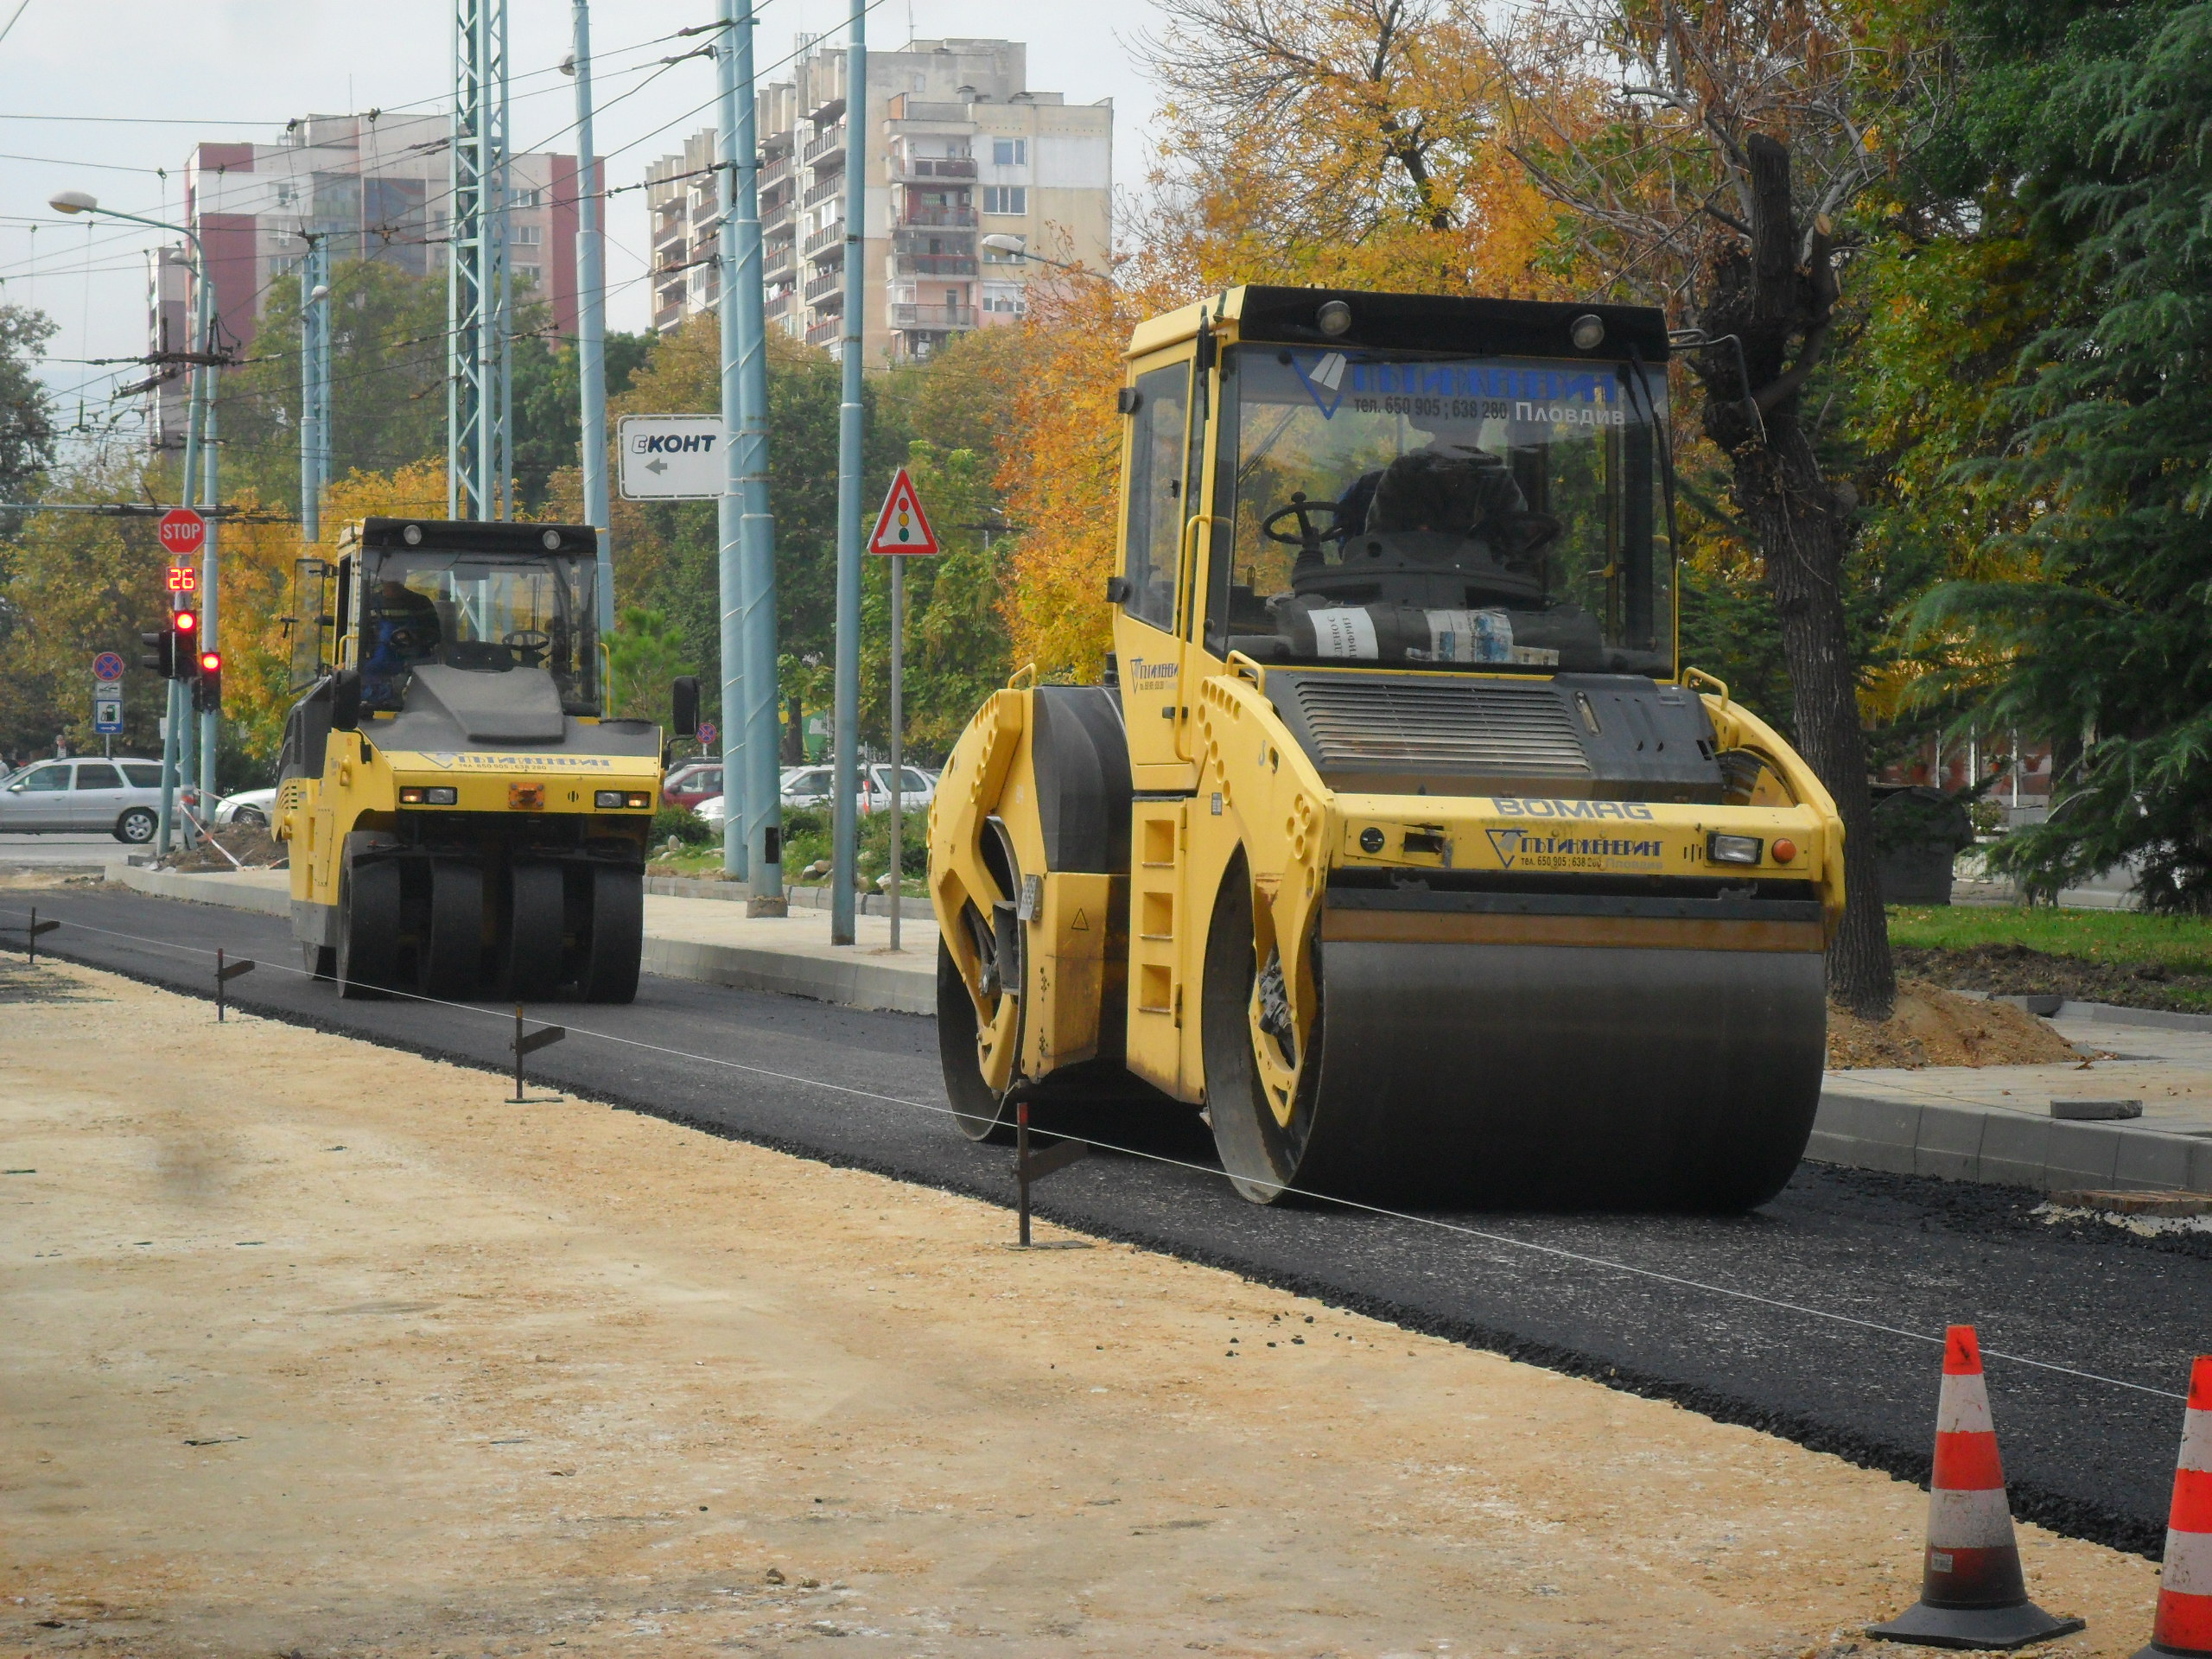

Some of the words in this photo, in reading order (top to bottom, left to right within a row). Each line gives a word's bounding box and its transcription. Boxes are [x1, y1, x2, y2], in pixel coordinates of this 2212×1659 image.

[1354, 398, 1380, 414] тел.
[1384, 397, 1410, 415] 650
[1414, 397, 1440, 416] 905
[1452, 400, 1478, 419] 638
[1481, 401, 1508, 420] 280
[162, 523, 200, 540] STOP
[168, 569, 195, 589] 26
[1491, 798, 1654, 820] BOMAG
[1521, 836, 1665, 857] ПЪТИНЖЕНЕРИНГ
[1521, 857, 1535, 867] тел.
[1537, 855, 1552, 867] 650
[1553, 856, 1567, 868] 905
[1572, 856, 1586, 868] 638
